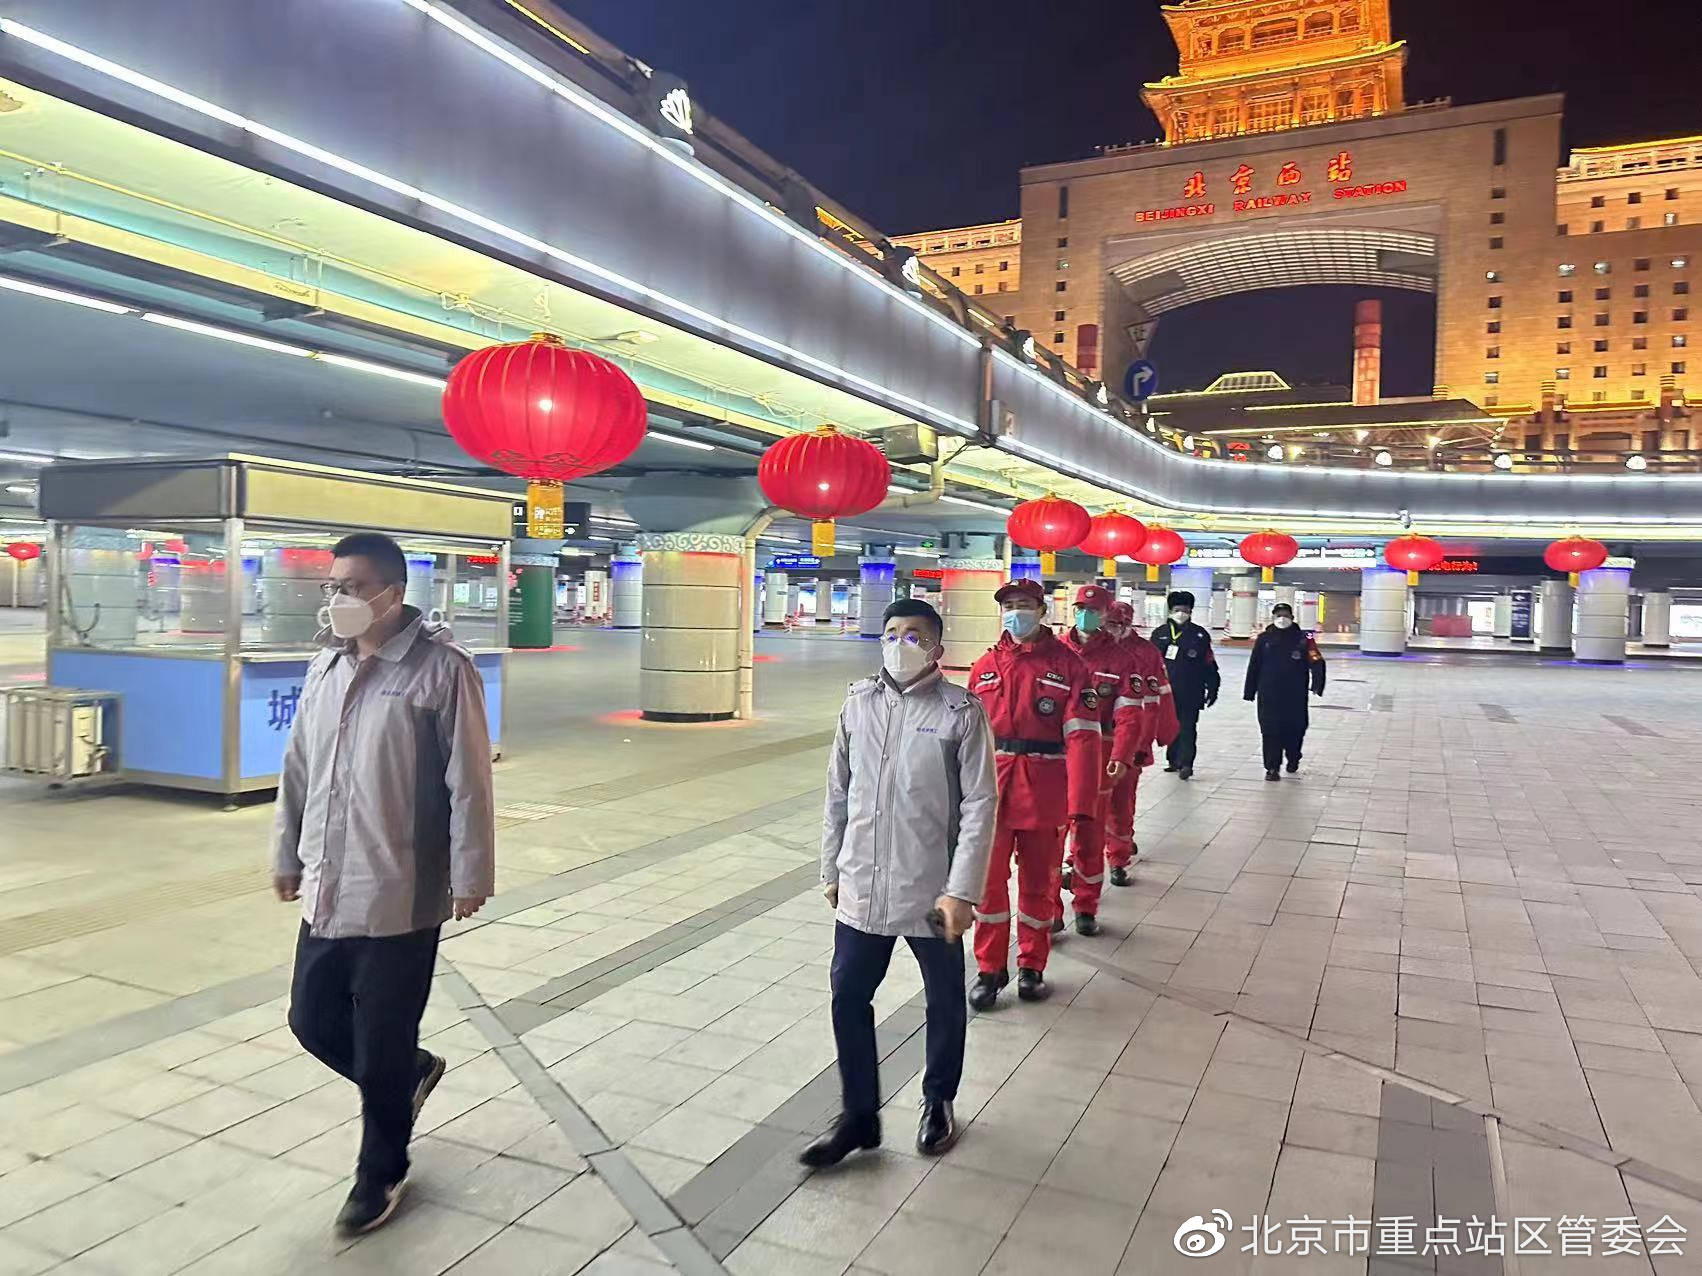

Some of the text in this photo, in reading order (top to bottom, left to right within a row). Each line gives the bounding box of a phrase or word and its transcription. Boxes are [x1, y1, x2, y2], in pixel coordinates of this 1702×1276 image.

[1183, 151, 1353, 199] 北京西站
[1135, 180, 1407, 223] BEIJINGXI RAILWAY STATION
